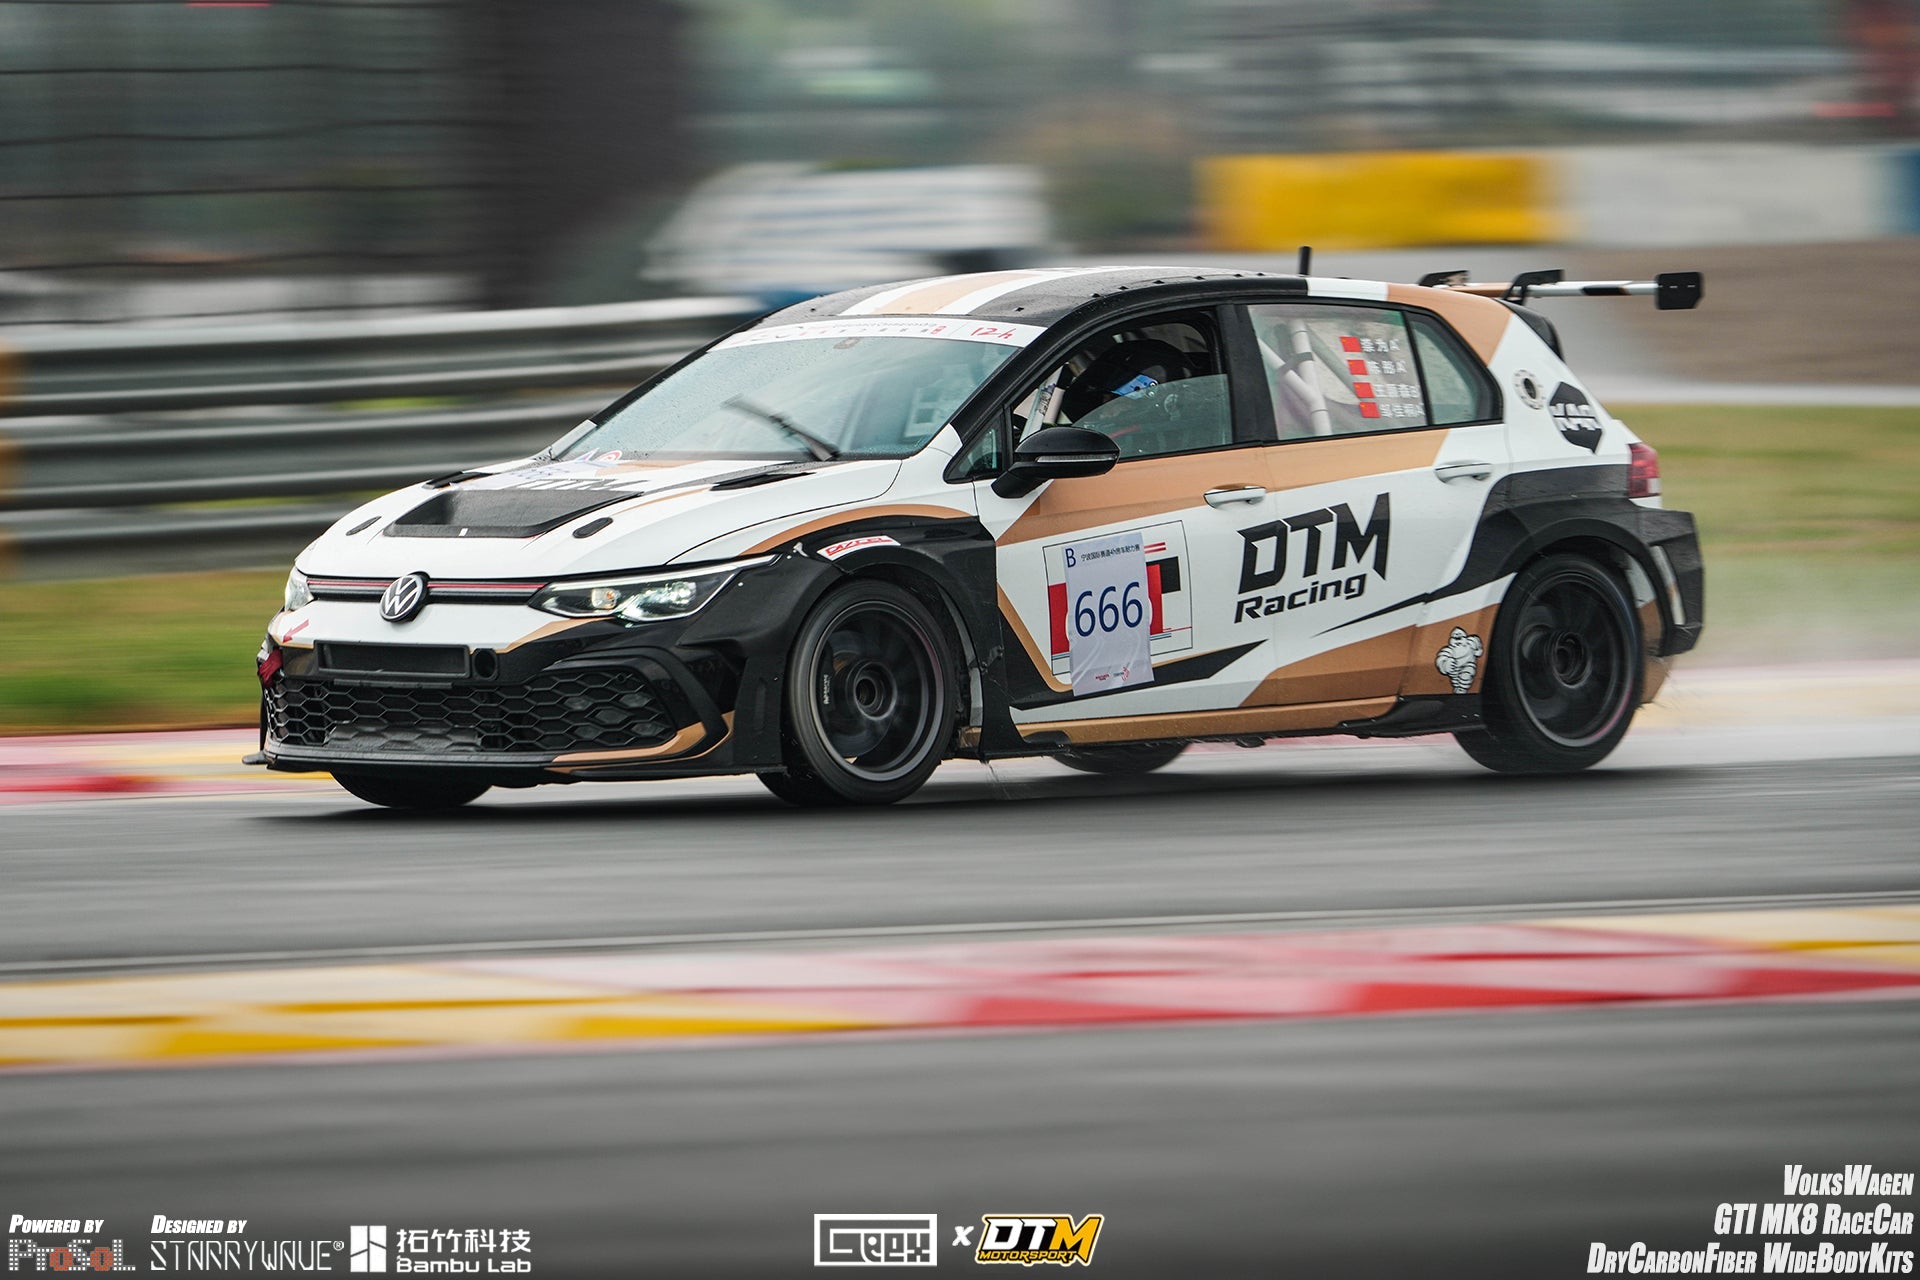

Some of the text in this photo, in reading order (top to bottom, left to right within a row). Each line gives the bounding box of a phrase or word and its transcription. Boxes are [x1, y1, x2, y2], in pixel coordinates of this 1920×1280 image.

[1065, 548, 1076, 568] B
[1237, 492, 1390, 595] DTM
[1075, 581, 1143, 637] 666
[1234, 573, 1367, 624] Racing
